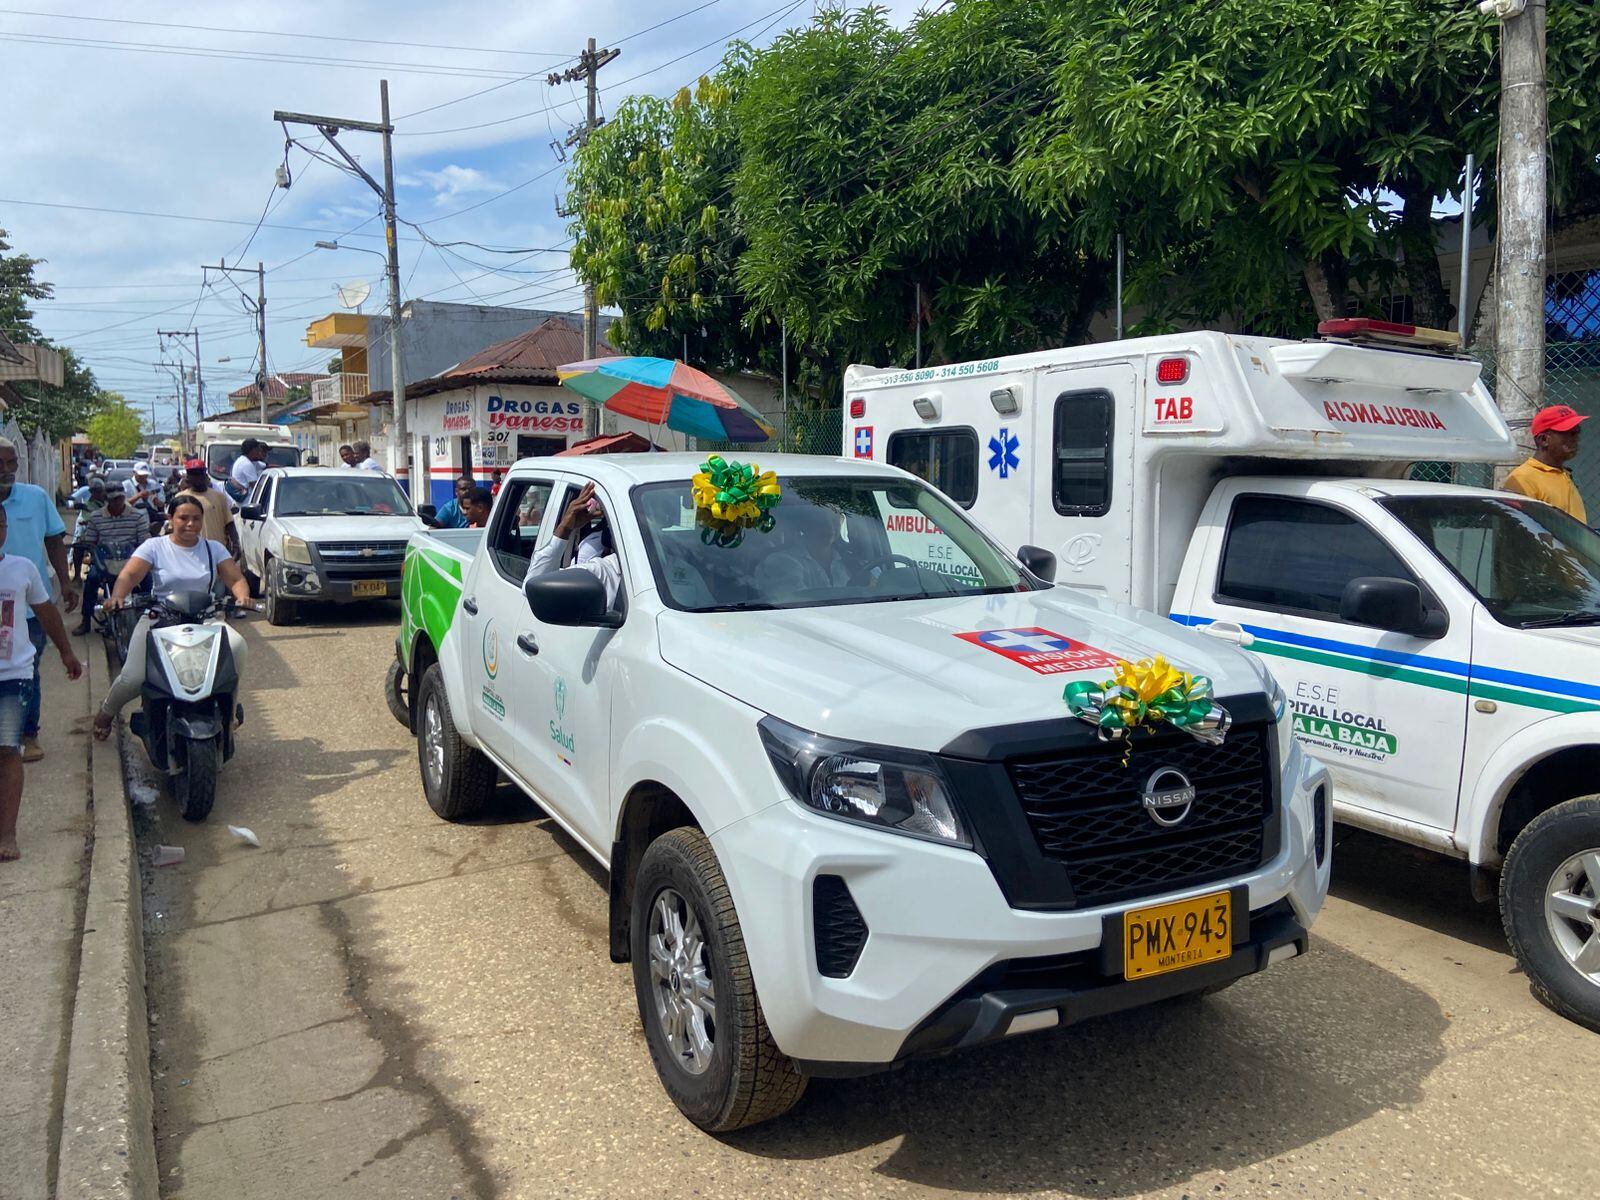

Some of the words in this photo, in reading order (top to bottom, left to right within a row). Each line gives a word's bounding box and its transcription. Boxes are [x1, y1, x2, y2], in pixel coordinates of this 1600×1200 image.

[941, 366, 957, 377] 314
[959, 363, 975, 375] 550
[976, 360, 1000, 373] 5608
[446, 400, 470, 415] DROGAS
[487, 396, 580, 415] DROGAS
[1154, 397, 1193, 420] TAB
[487, 431, 510, 443] 30%
[887, 515, 945, 534] AMBULA
[928, 545, 953, 560] E.S.E
[914, 561, 948, 574] SPITAL
[950, 564, 980, 578] LOCAL
[1018, 649, 1101, 664] MISION
[1297, 682, 1338, 704] E.S.E
[1288, 700, 1329, 719] PITAL
[1333, 709, 1387, 732] LOCAL
[550, 720, 575, 754] Salud
[1310, 720, 1334, 739] LA
[1338, 727, 1391, 753] BAJA
[1294, 733, 1332, 749] ompromiso
[1333, 743, 1348, 754] Tuyo
[1355, 748, 1386, 762] Nuestro!
[1145, 790, 1196, 806] NISSAN
[1129, 915, 1177, 960] PMX
[1184, 904, 1228, 949] 943
[1158, 949, 1204, 968] MONTERIA
